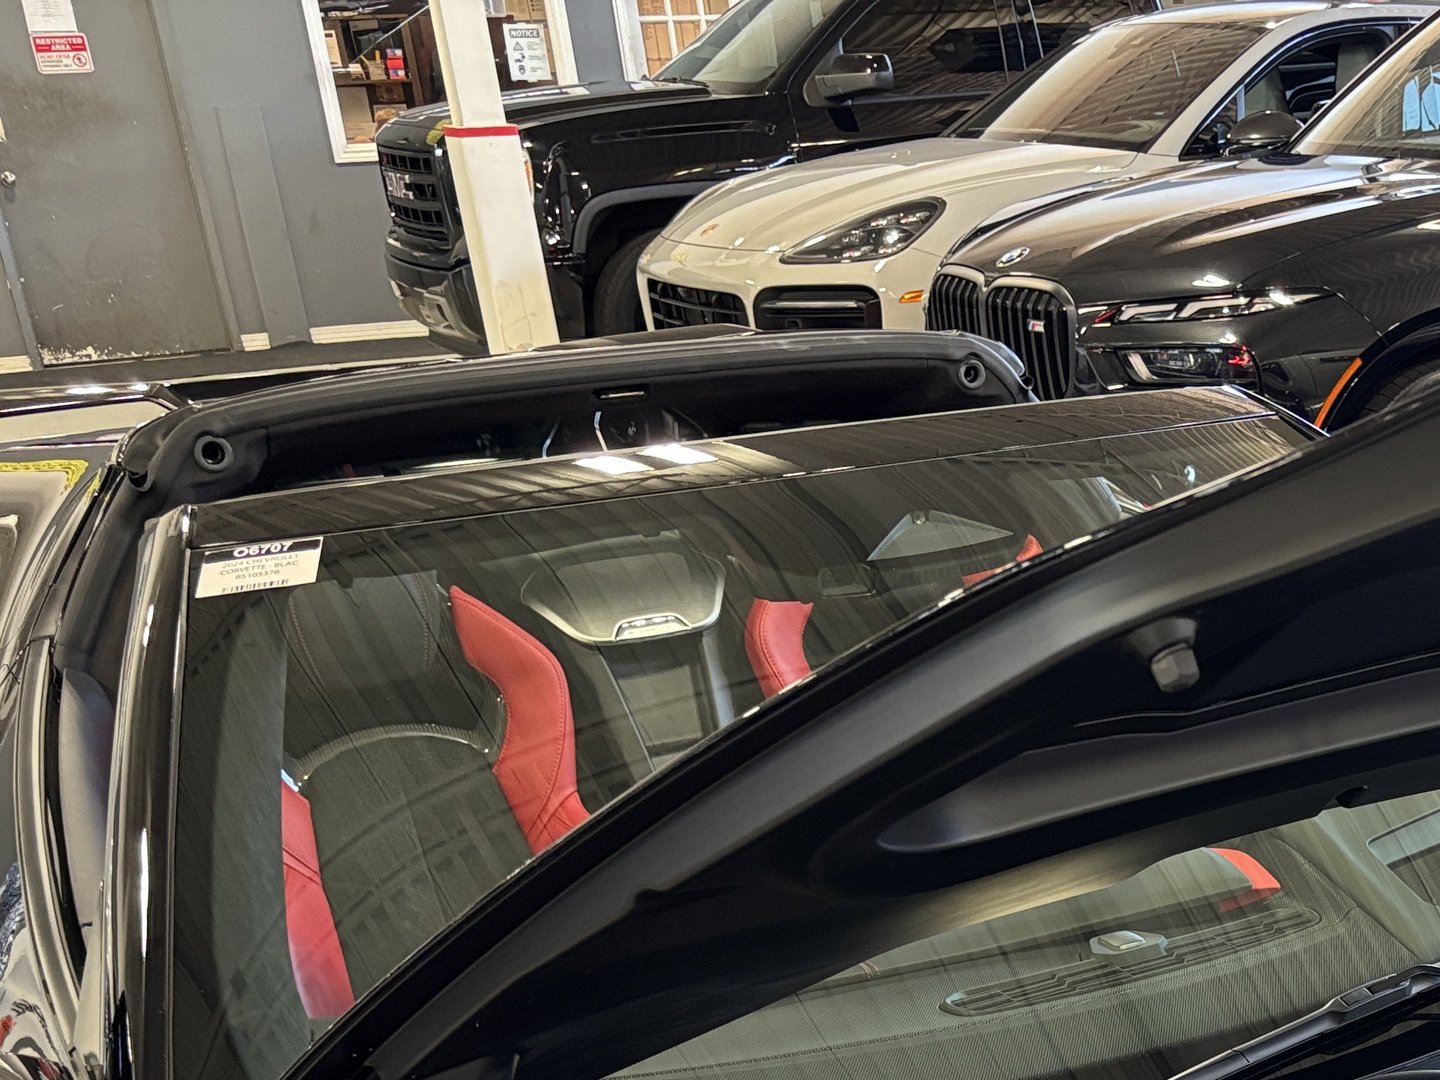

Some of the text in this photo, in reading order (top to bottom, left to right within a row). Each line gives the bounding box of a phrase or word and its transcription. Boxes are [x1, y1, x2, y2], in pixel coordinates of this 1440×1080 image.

[35, 37, 83, 45] RESTRICTED
[219, 564, 267, 576] CORVETTE
[274, 560, 299, 568] BLAC
[221, 554, 299, 569] 2024 CHEVROLET
